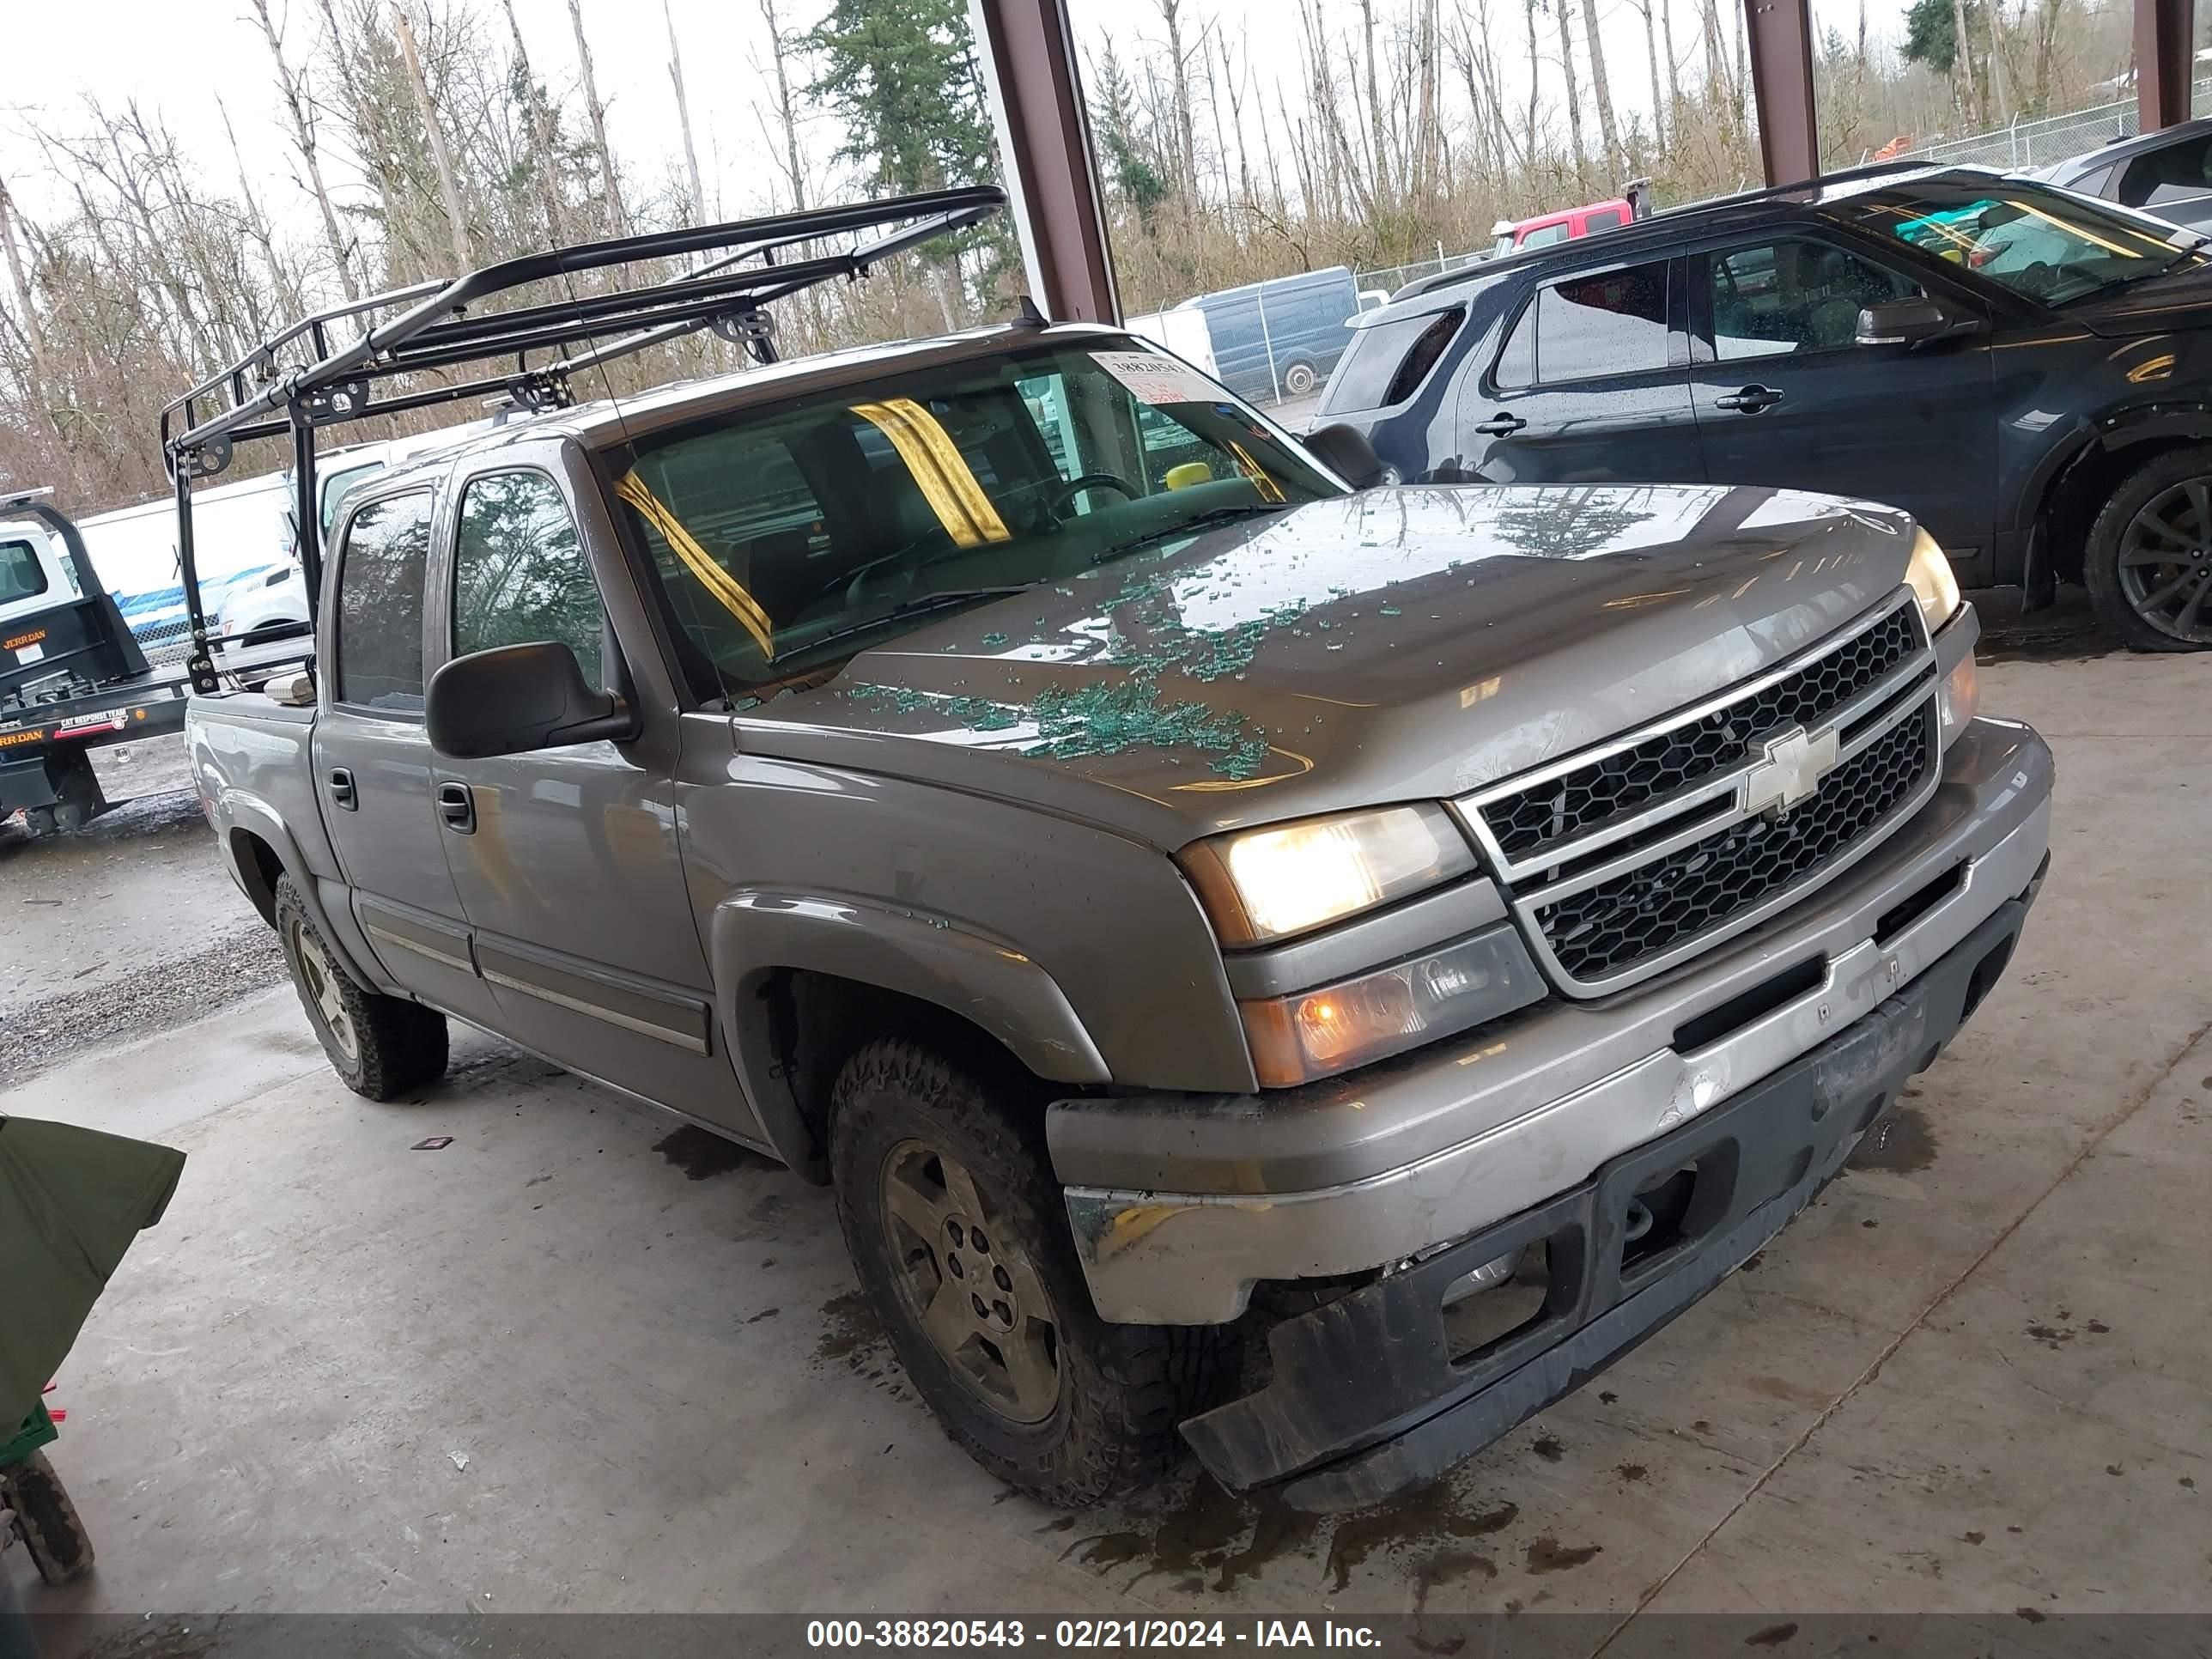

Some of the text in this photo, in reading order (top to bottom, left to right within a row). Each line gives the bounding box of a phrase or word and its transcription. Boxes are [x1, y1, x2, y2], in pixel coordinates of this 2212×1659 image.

[1112, 362, 1187, 374] 38820543
[61, 708, 127, 727] CAT RESPONSE TEAM
